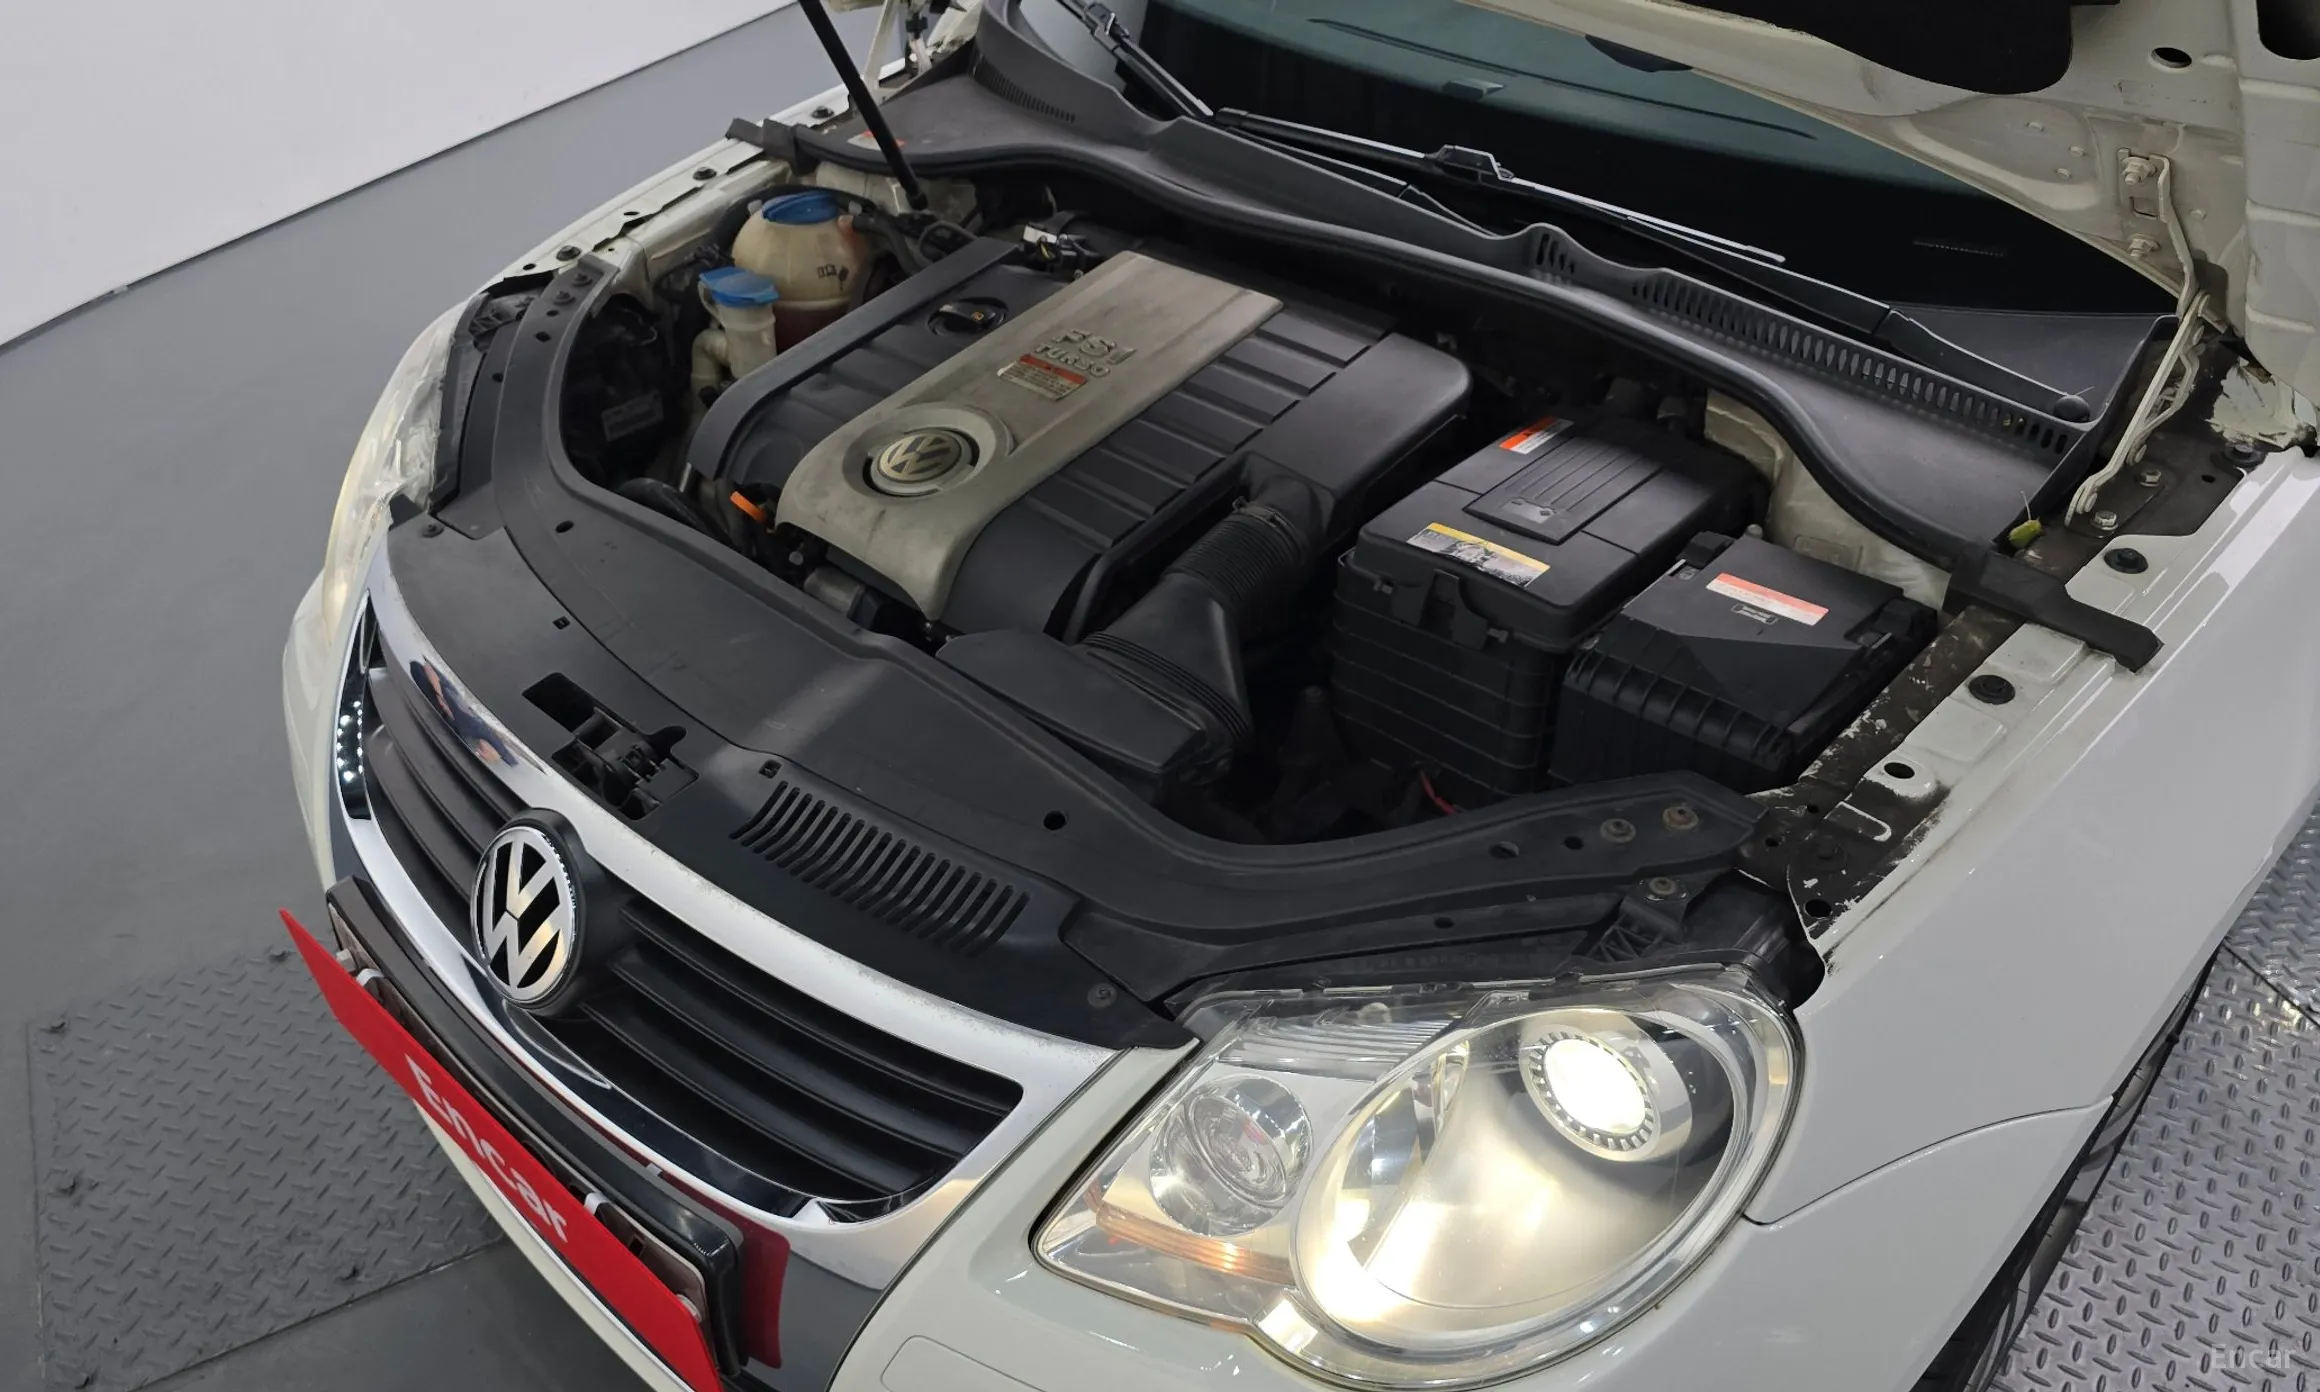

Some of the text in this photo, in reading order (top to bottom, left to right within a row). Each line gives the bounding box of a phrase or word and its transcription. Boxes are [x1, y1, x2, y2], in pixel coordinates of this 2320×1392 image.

[1034, 343, 1111, 378] TURBO
[1052, 328, 1137, 365] FSI
[404, 1053, 568, 1243] Encar
